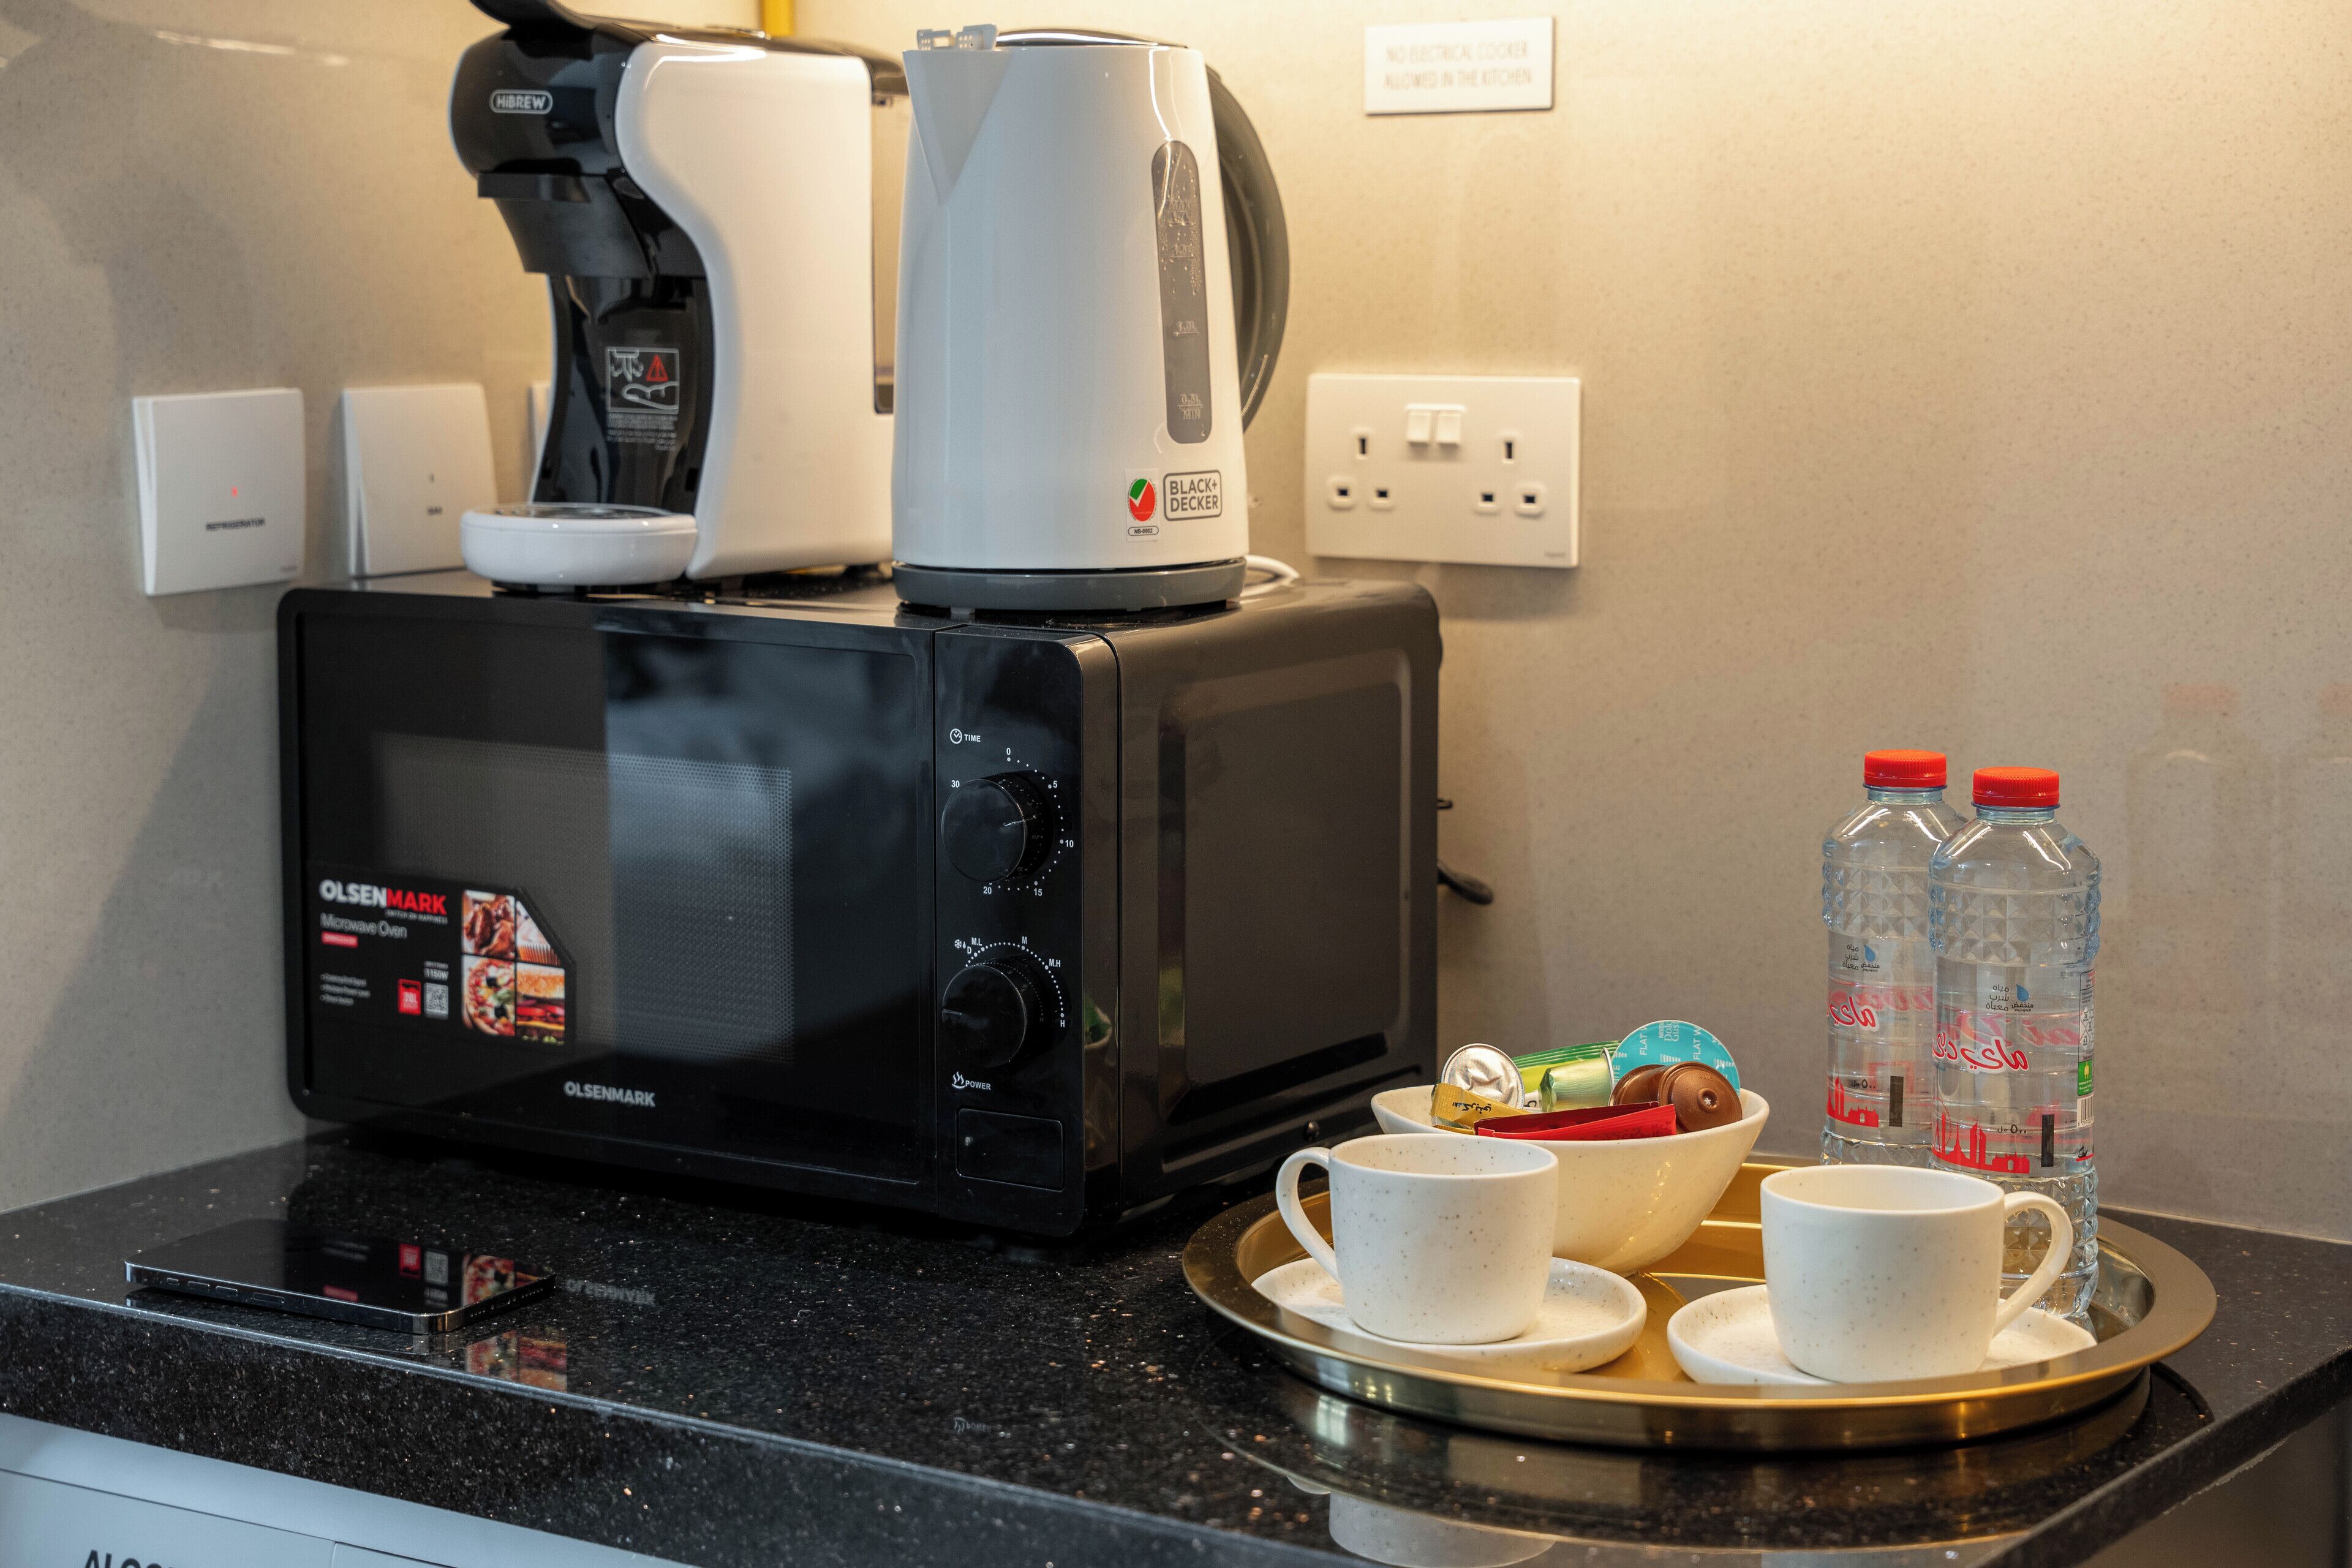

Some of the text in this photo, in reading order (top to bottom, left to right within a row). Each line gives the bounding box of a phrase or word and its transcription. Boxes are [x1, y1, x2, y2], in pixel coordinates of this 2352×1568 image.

[1169, 478, 1218, 496] BLACK+
[1170, 495, 1218, 512] DECKER
[964, 734, 981, 742] TIME
[983, 886, 992, 895] 20
[1034, 888, 1042, 897] 15
[319, 879, 447, 916] OLSENMARK
[320, 913, 408, 939] Microwave Oven
[1022, 936, 1028, 944] M
[1844, 952, 1859, 961] شرب
[1049, 959, 1061, 968] M.H
[1989, 993, 2009, 1001] شرب
[965, 1080, 991, 1090] POWER
[563, 1080, 656, 1108] OLSENMARK
